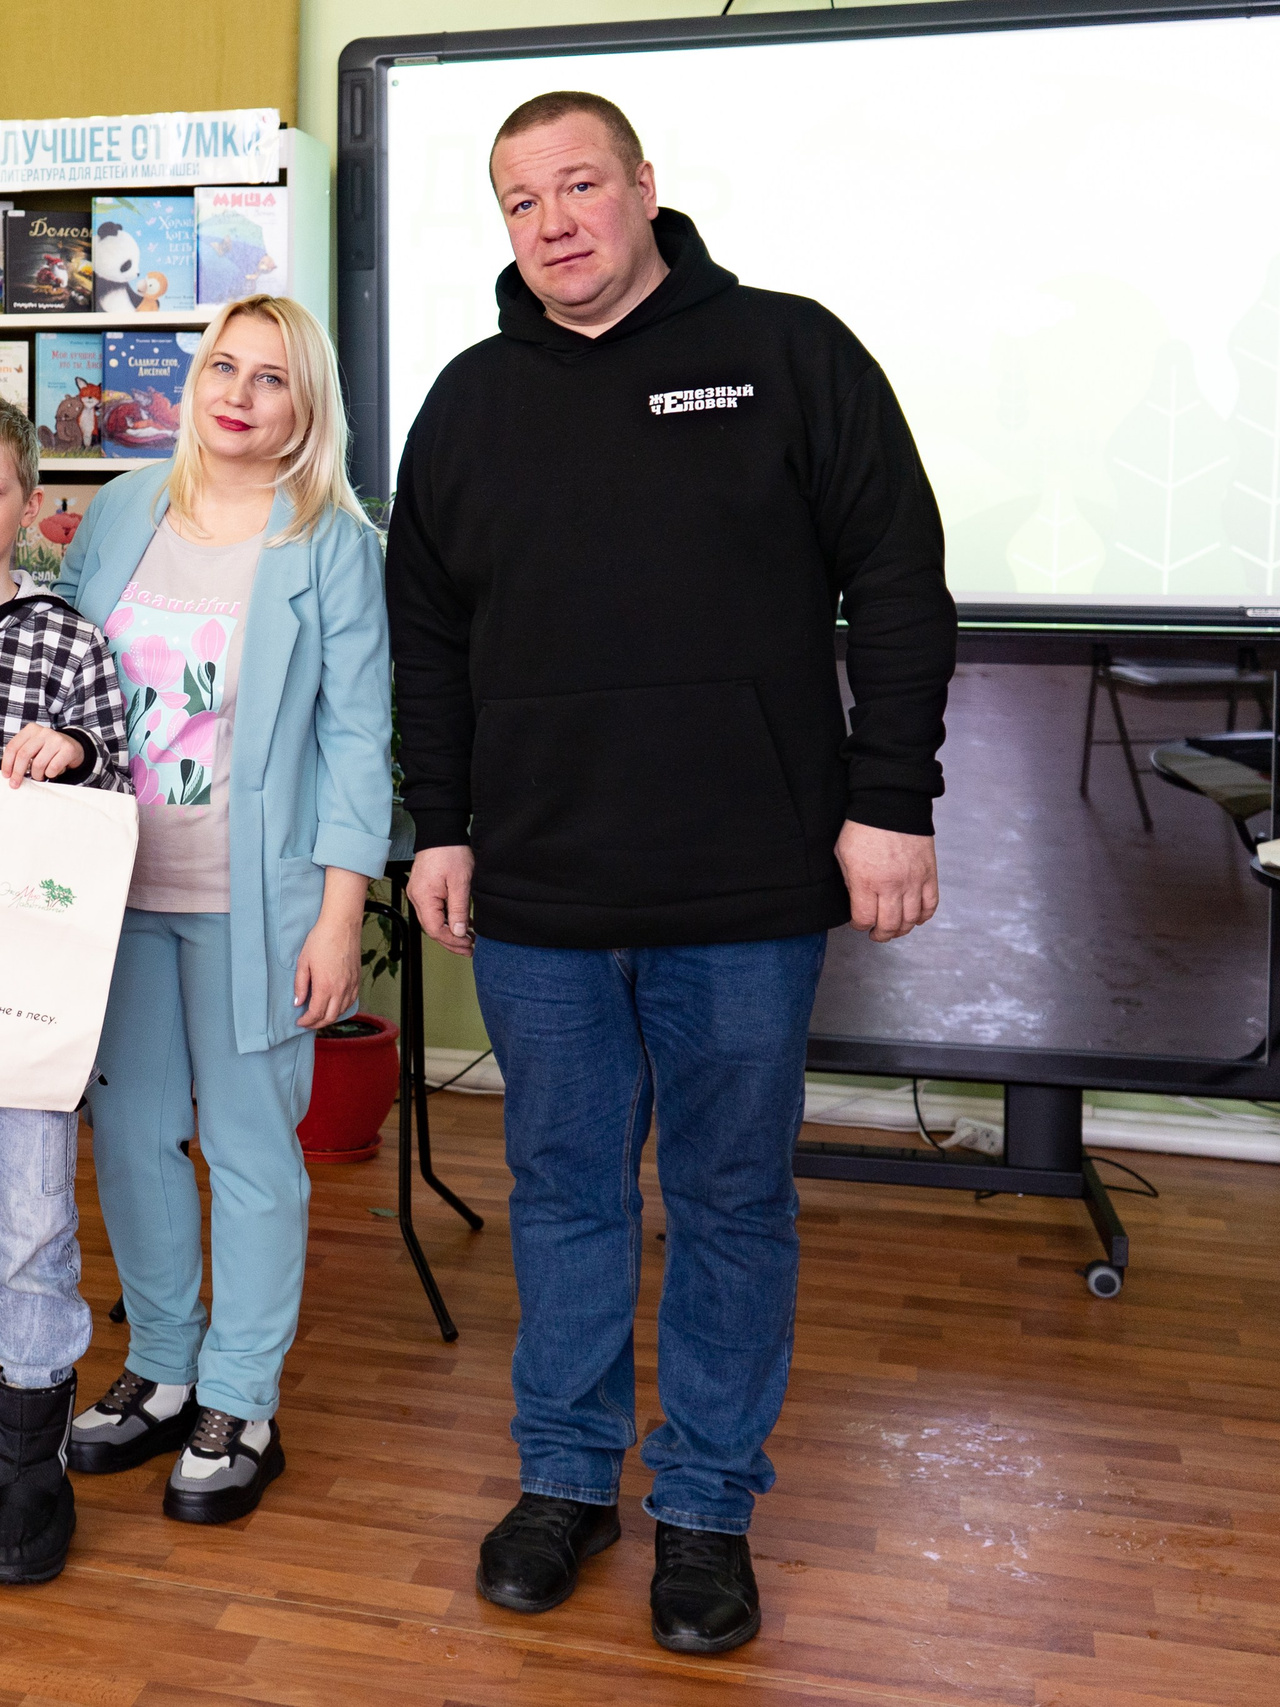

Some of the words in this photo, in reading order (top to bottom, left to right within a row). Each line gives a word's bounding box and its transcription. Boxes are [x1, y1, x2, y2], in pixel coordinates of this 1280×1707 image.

[1, 125, 122, 166] ЛУЧШЕЕ
[0, 165, 66, 184] ЛИТЕРАТУРА
[68, 165, 91, 182] ДЛЯ
[94, 161, 128, 181] ДЕТЕЙ
[131, 161, 138, 178] И
[213, 193, 276, 208] МИША
[17, 1009, 23, 1018] в
